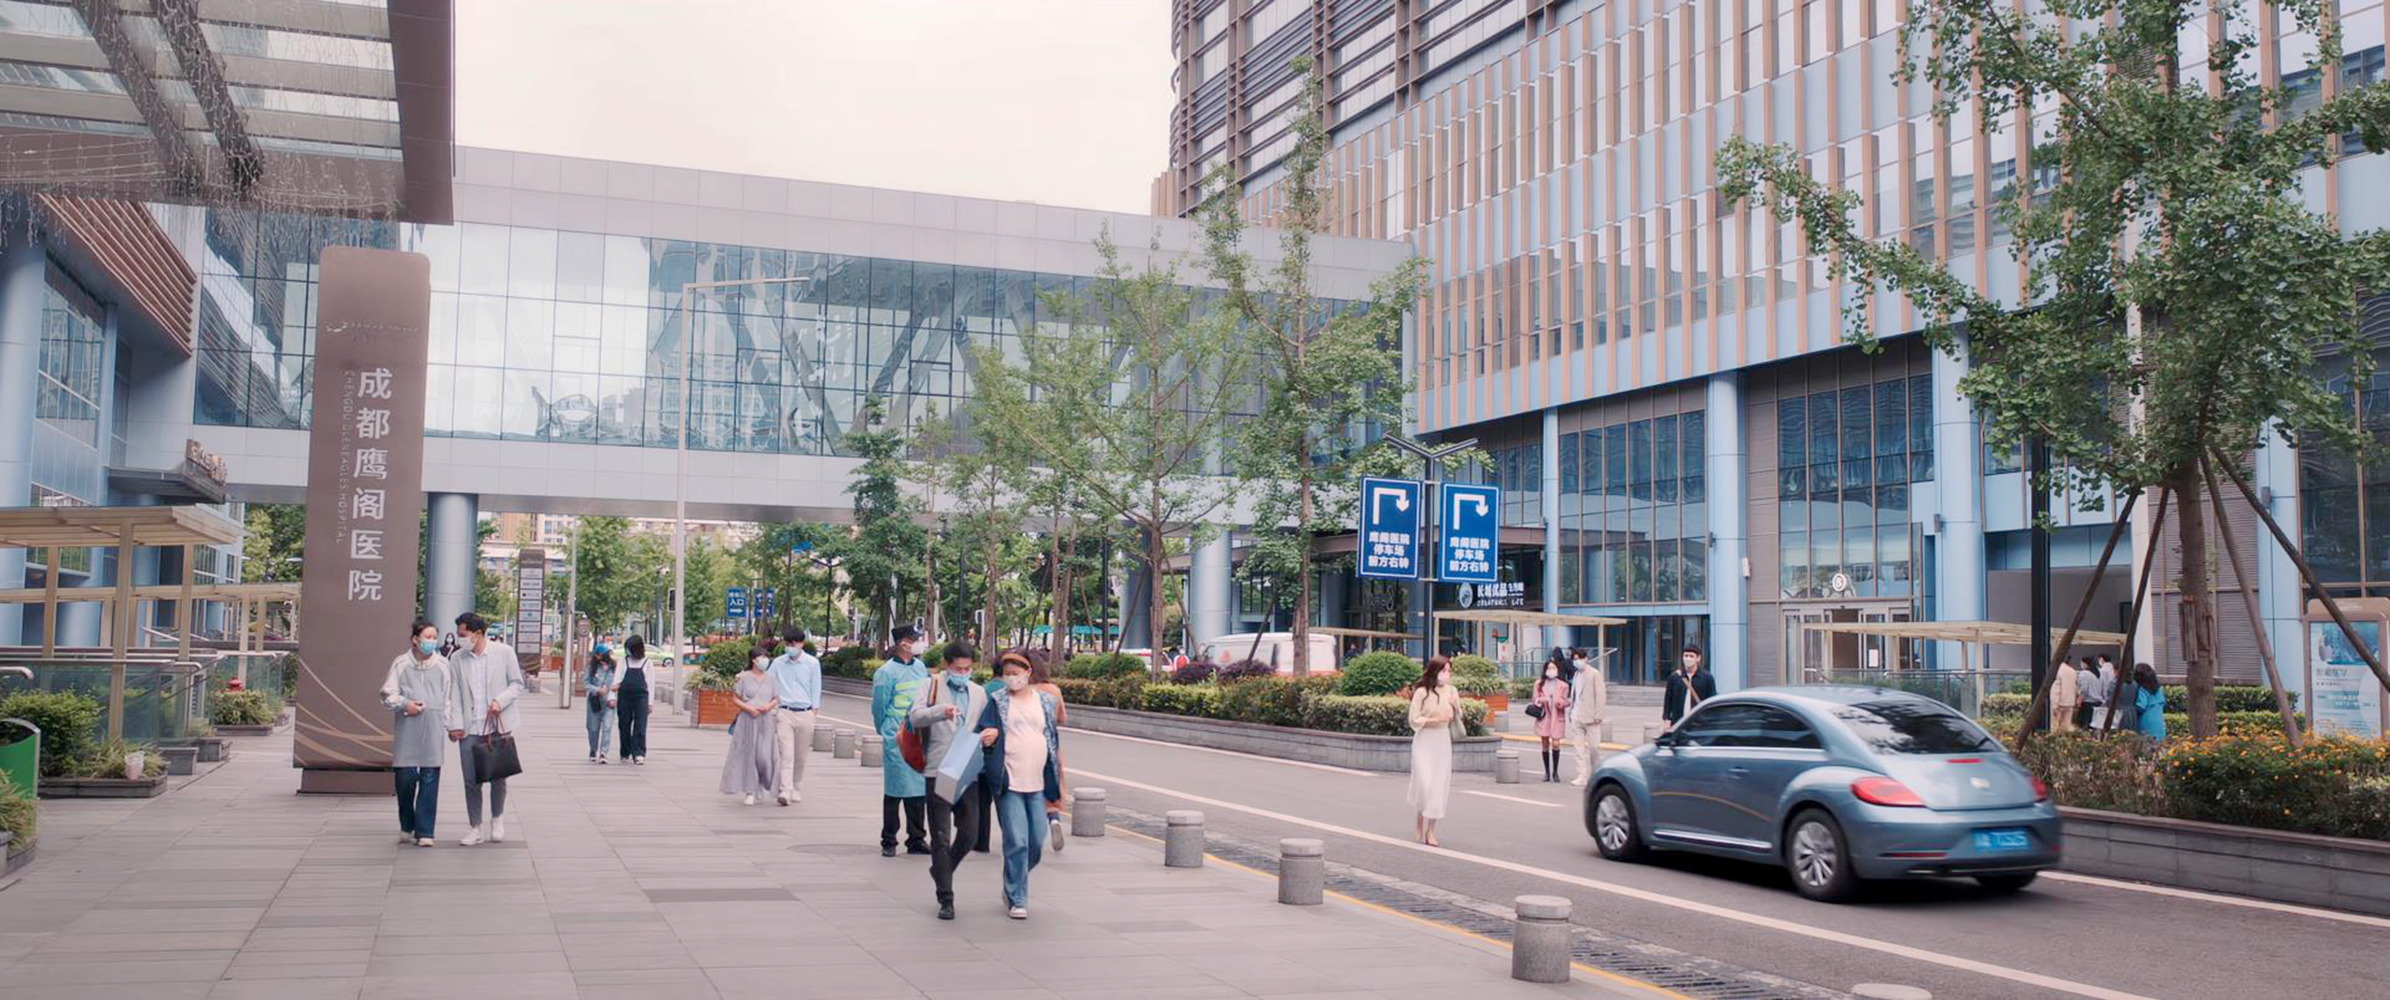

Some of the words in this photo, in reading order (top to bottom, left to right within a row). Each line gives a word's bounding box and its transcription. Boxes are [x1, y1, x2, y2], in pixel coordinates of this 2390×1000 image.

[342, 370, 355, 420] CHENGDU
[348, 367, 393, 601] 成都鹰阁医院
[336, 493, 348, 544] HOSPITAL
[1374, 543, 1404, 556] 停车场
[1454, 549, 1485, 561] 停车场
[1368, 556, 1410, 569] 前方右转
[1449, 560, 1490, 573] 前方右转
[730, 598, 745, 606] 入口
